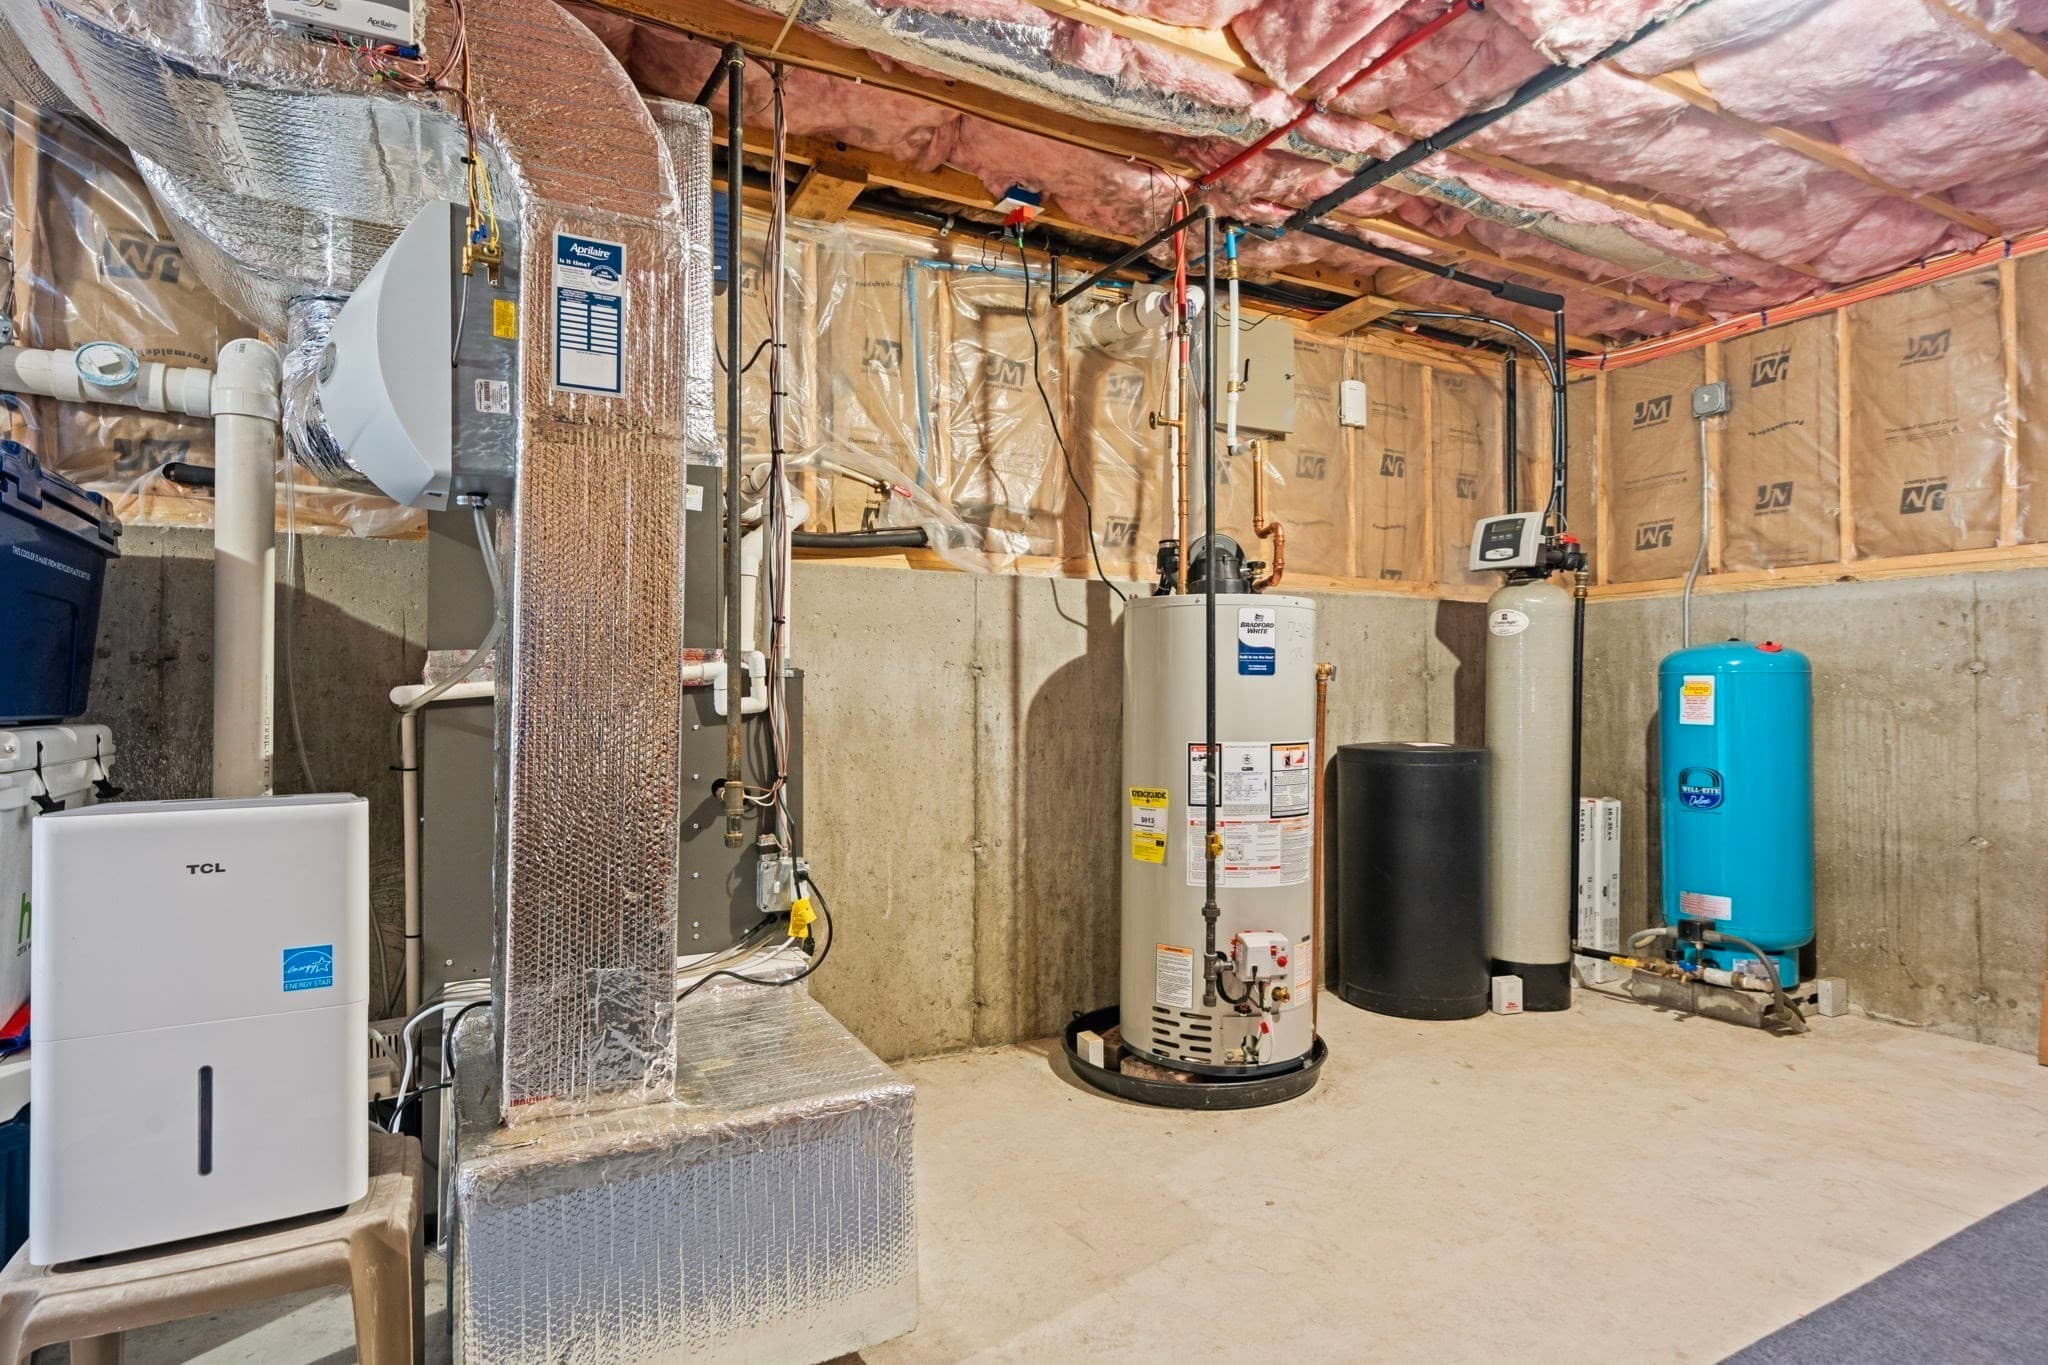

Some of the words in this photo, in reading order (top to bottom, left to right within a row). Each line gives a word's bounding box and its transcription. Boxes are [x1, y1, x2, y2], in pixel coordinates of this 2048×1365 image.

[367, 17, 398, 31] Aprilaire
[570, 243, 610, 259] Aprilaire
[1633, 395, 1672, 425] JM
[186, 863, 226, 874] TCL
[285, 980, 313, 990] ENERGY
[313, 978, 331, 987] STAR
